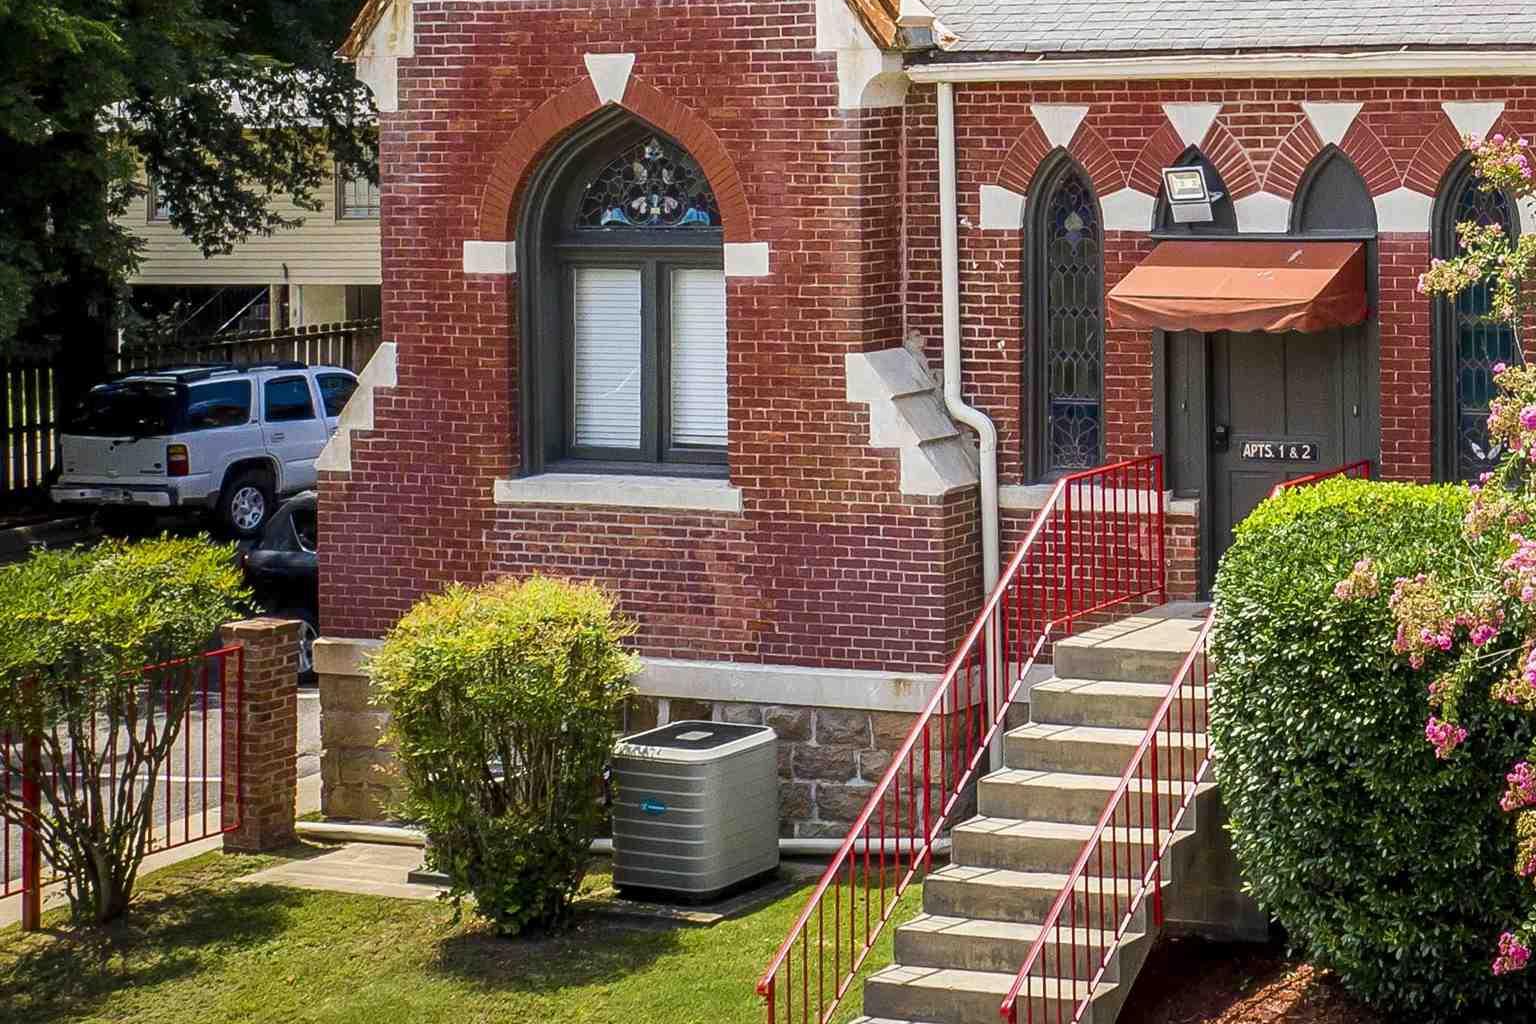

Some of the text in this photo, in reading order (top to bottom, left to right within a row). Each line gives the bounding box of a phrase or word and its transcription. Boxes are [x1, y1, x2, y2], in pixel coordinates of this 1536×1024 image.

[1243, 444, 1311, 459] APTS. 1 & 2
